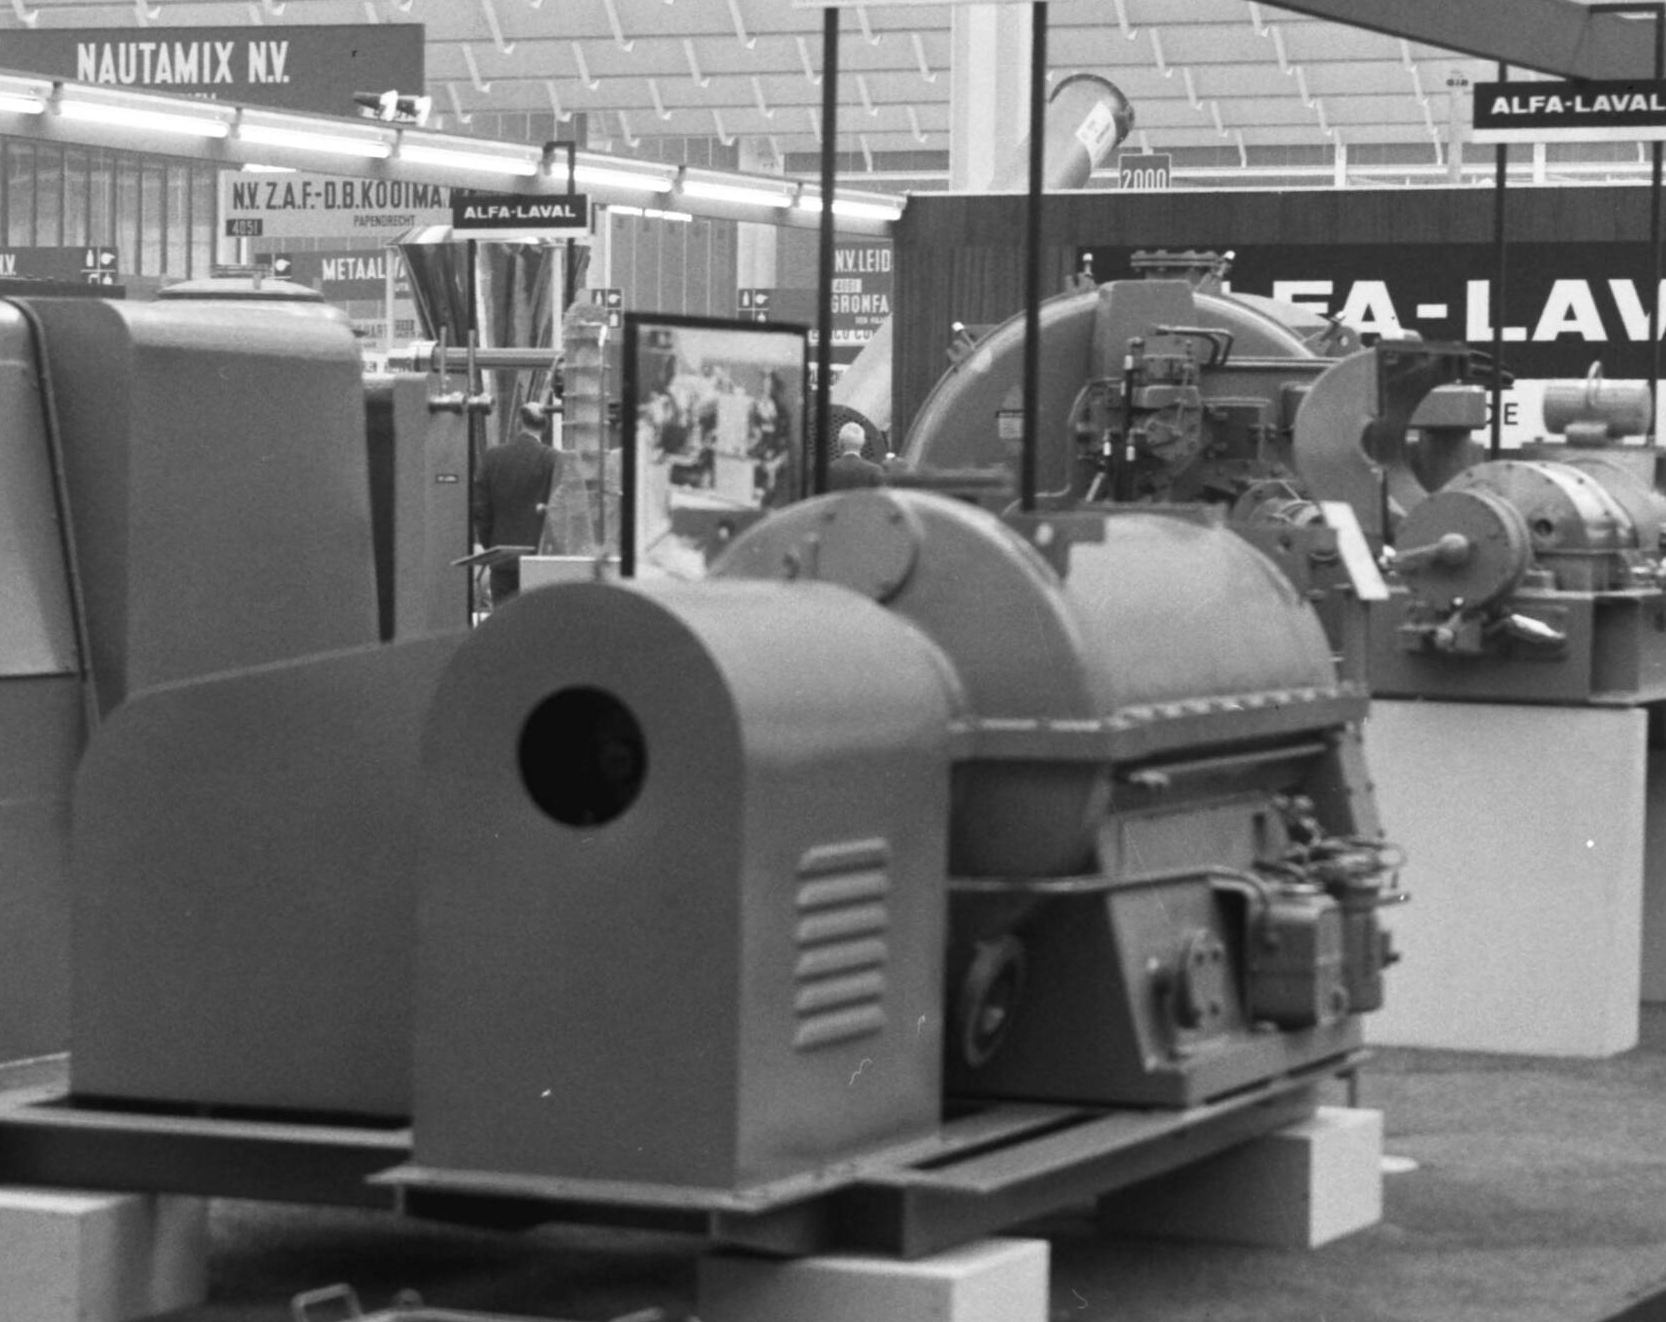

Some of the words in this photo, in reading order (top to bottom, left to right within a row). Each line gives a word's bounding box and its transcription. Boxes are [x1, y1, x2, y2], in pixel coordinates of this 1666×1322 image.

[77, 42, 235, 84] NAUTAMIX
[248, 41, 290, 84] N.V.
[1122, 168, 1167, 189] 2000
[233, 182, 261, 210] N.V.
[353, 214, 416, 229] PAPENDRECHT
[463, 203, 577, 221] ALFA-LAVAL
